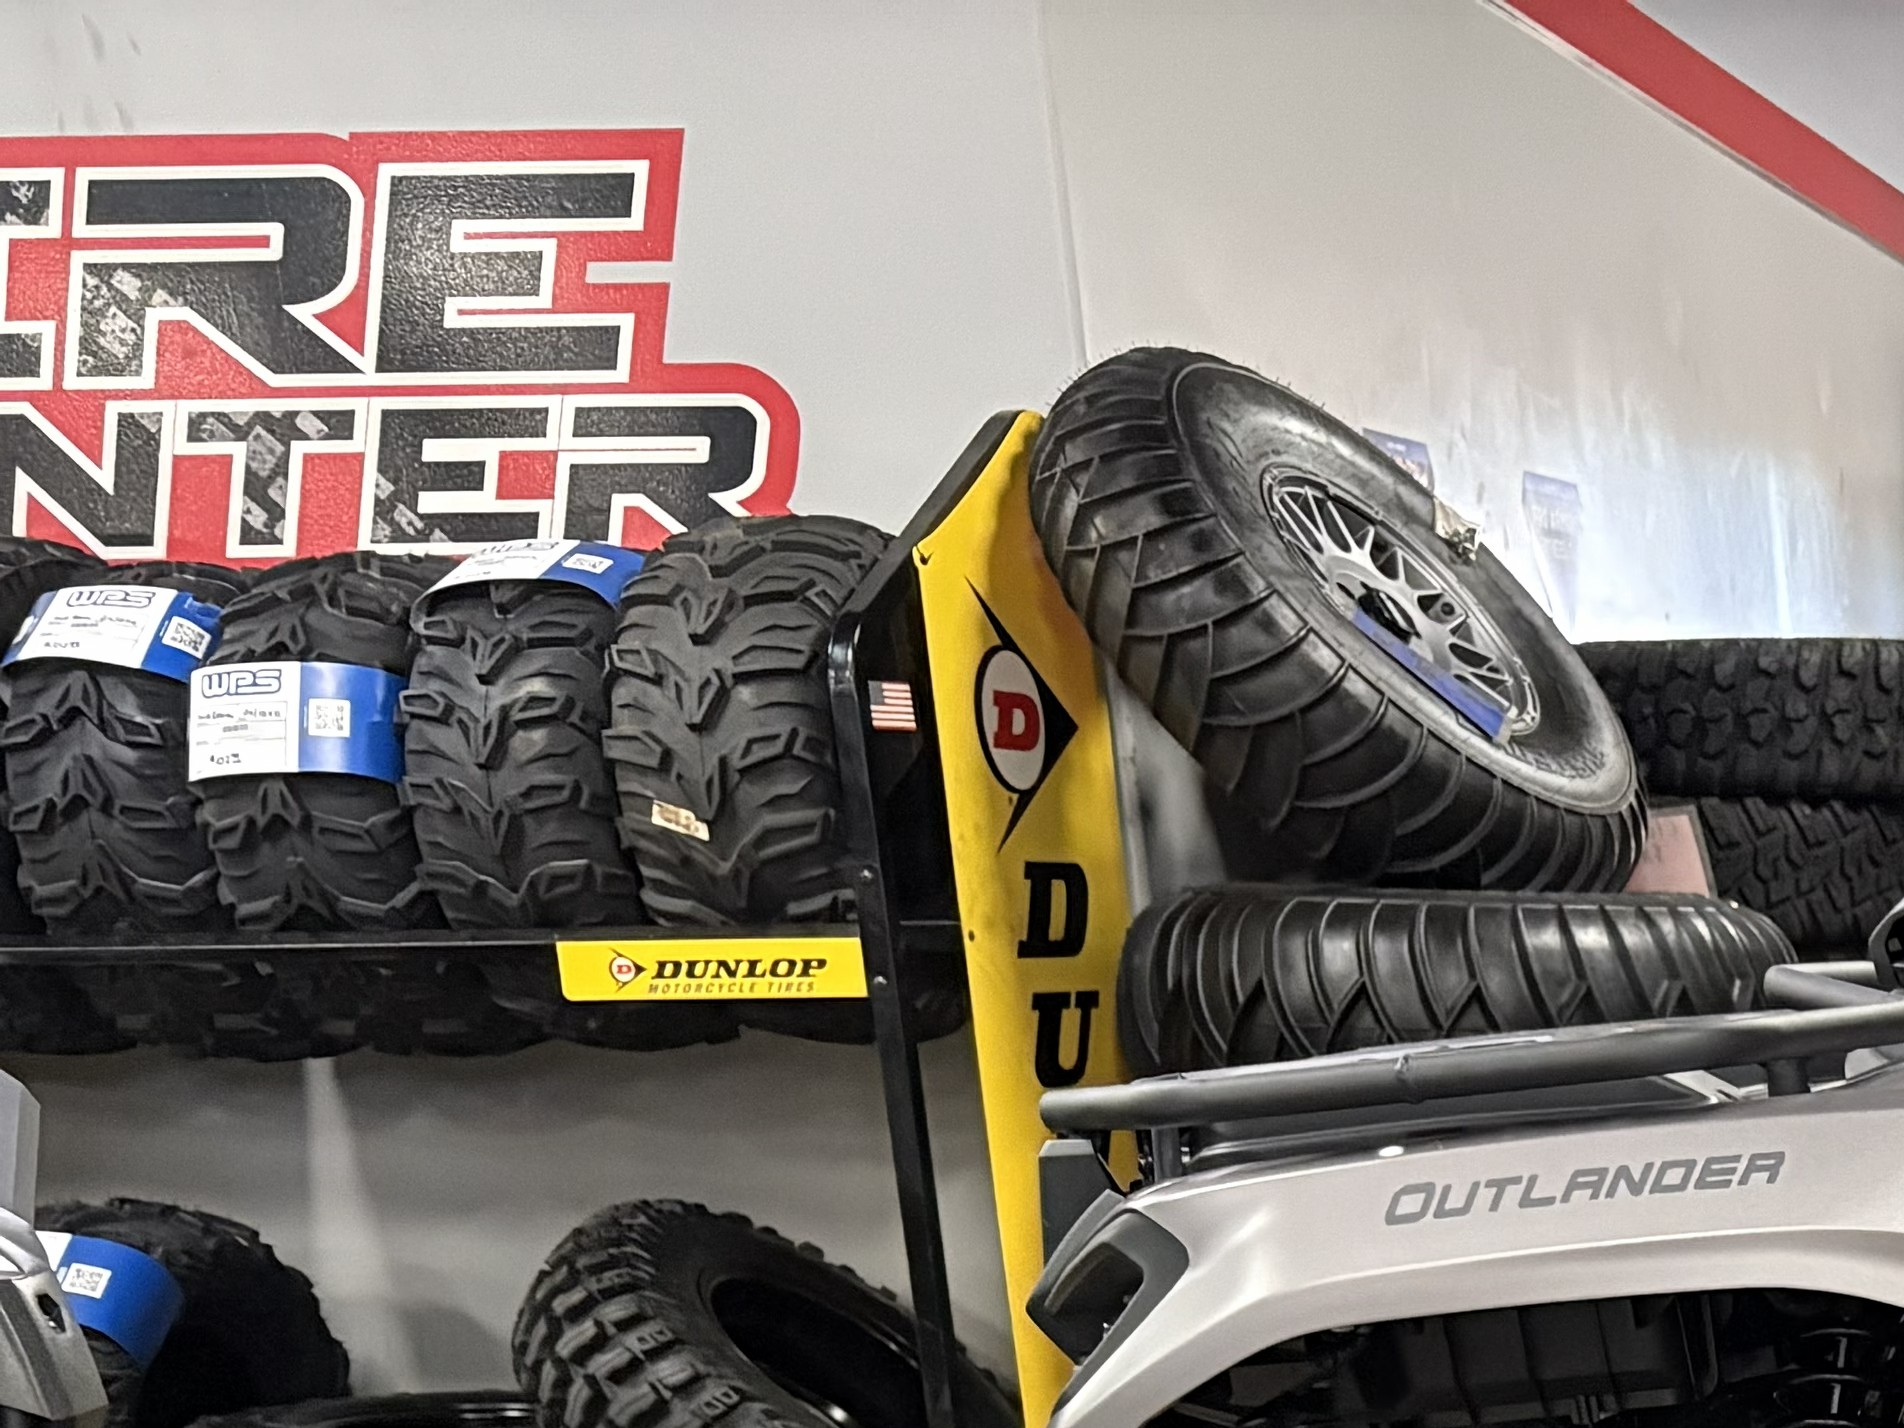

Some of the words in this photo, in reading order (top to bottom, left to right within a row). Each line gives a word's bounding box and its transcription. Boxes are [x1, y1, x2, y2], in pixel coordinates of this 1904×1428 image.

[66, 590, 156, 609] WPS
[202, 669, 282, 699] WPS
[993, 690, 1041, 752] D
[651, 958, 827, 980] DUNLOP
[648, 981, 757, 995] MOTORCYCLE
[767, 981, 815, 994] TIRES
[1384, 1150, 1787, 1226] OUTLANDER
